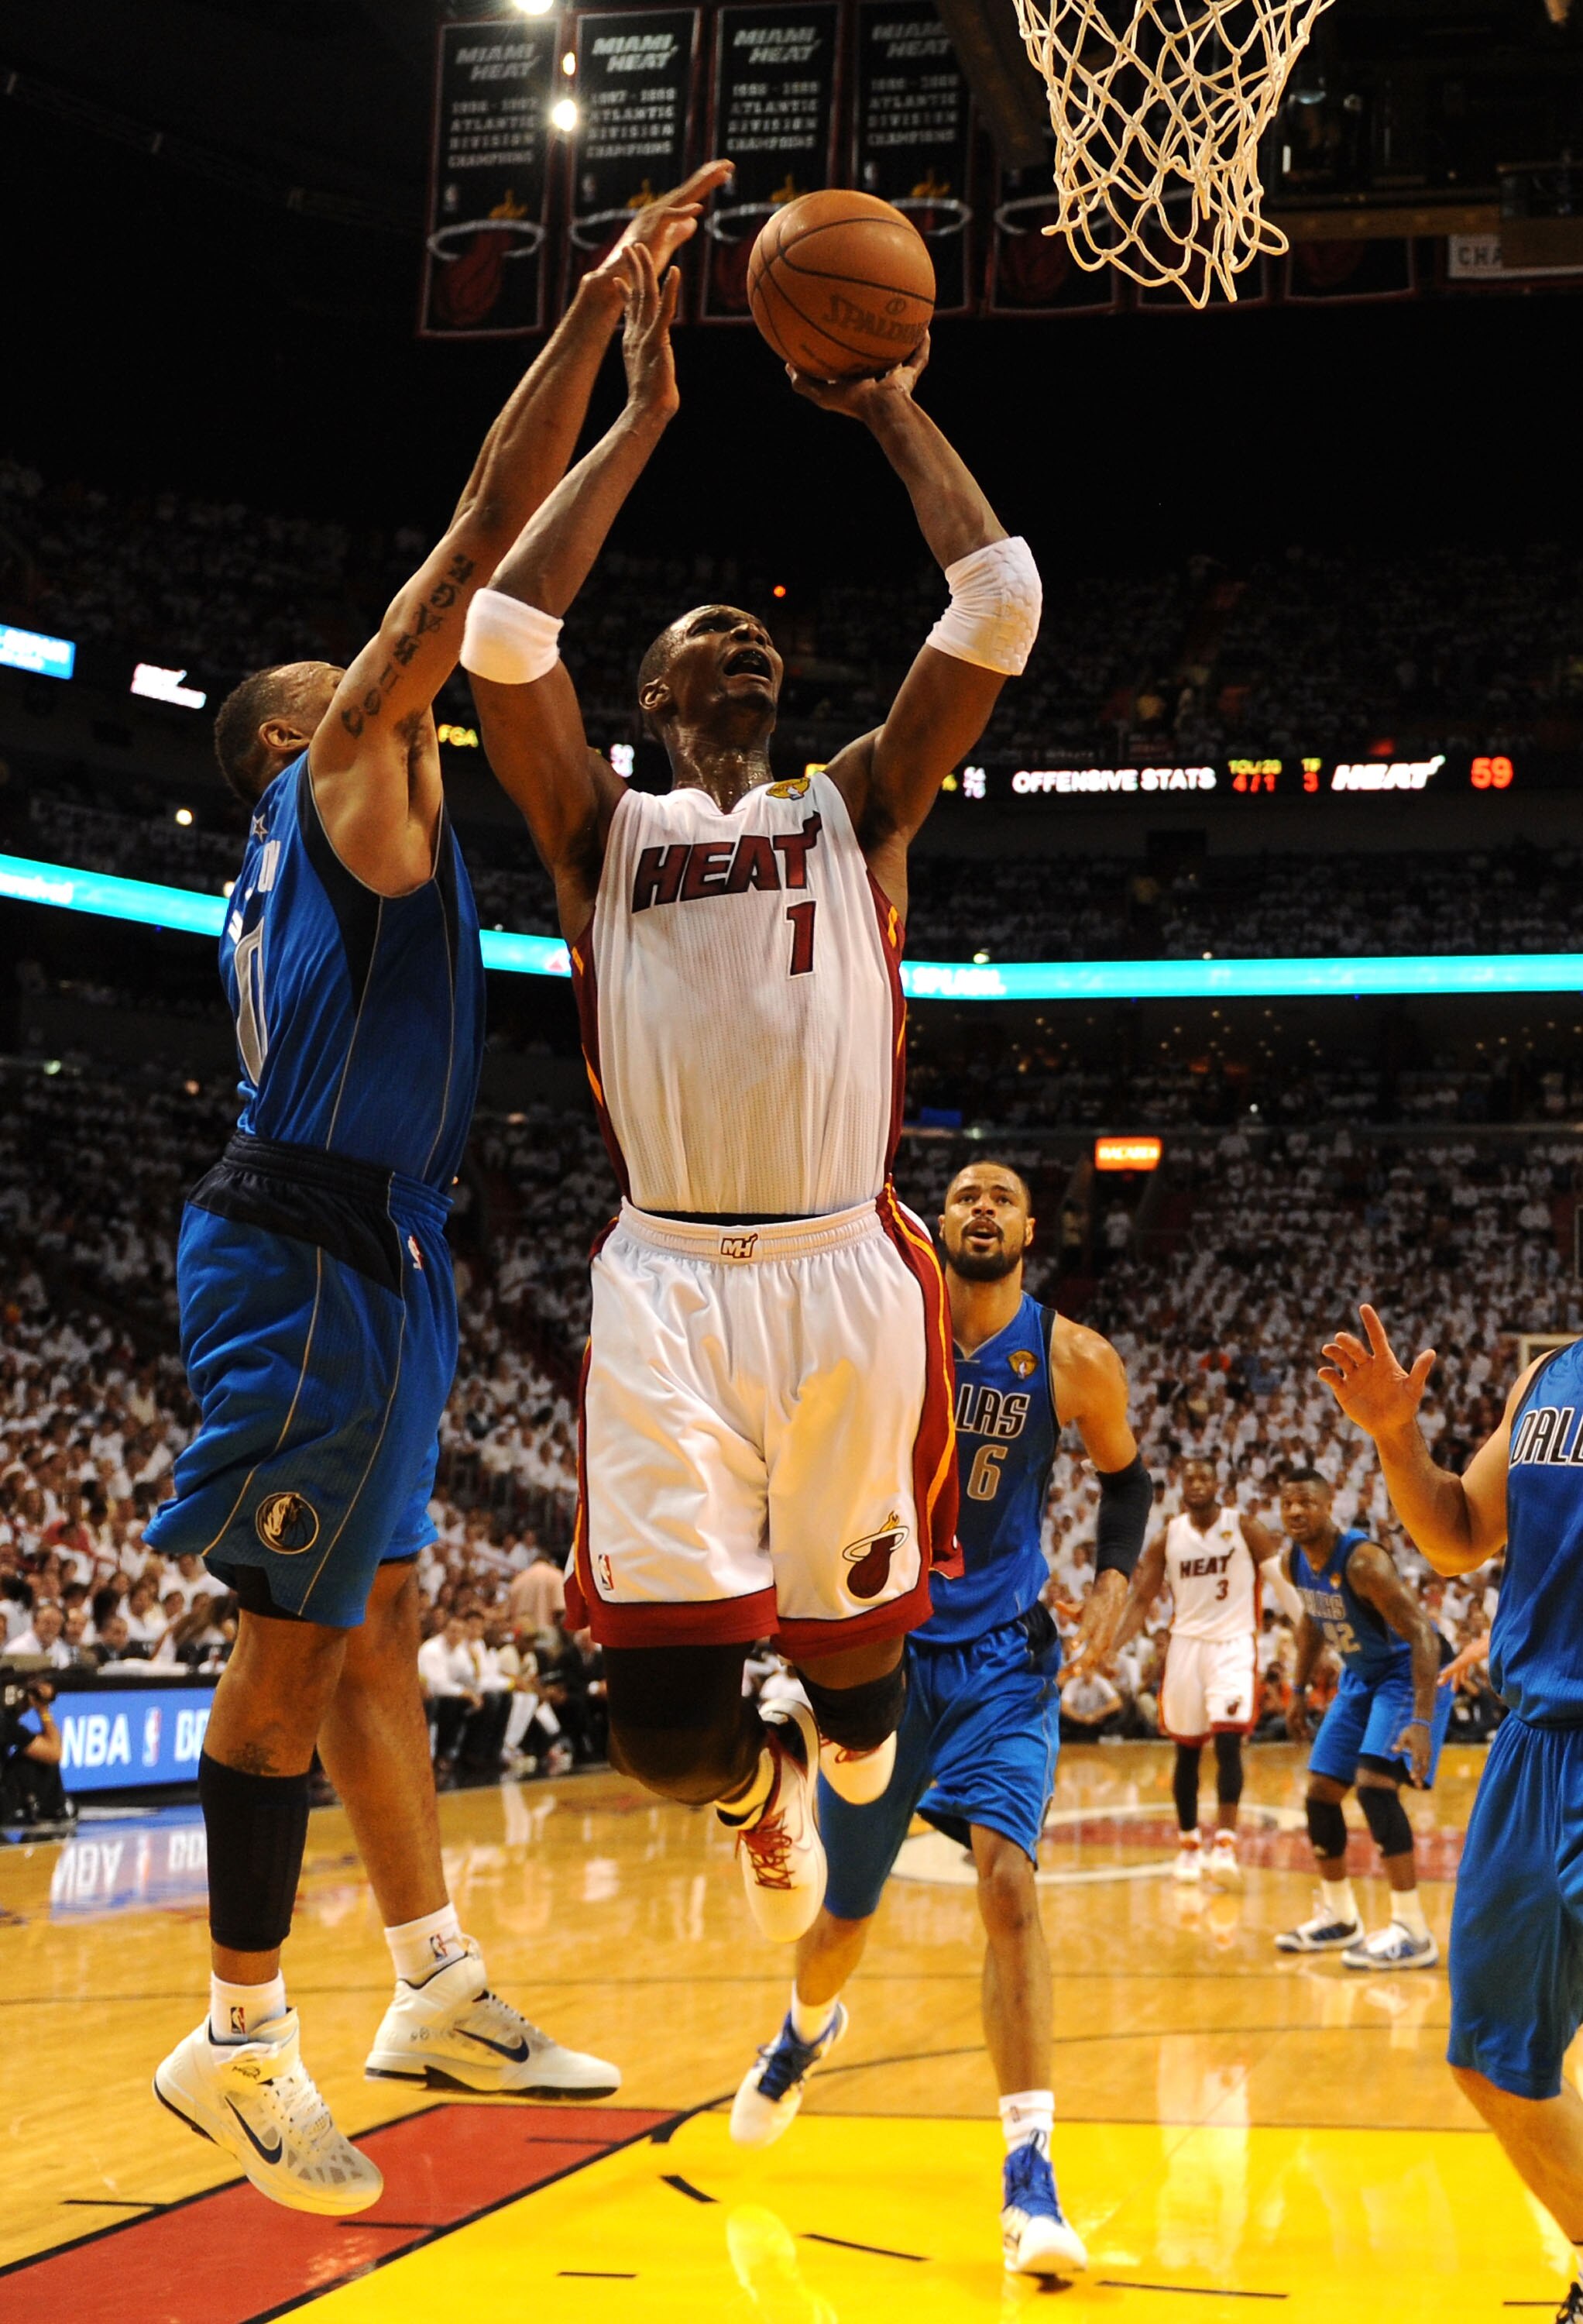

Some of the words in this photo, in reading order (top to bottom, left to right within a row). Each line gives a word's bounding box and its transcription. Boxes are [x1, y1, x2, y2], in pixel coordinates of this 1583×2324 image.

[592, 34, 673, 55] MIAMI
[733, 26, 816, 46] MIAMI
[455, 43, 534, 64] MIAMI
[606, 46, 678, 73] HEAT
[748, 39, 822, 64] HEAT
[471, 56, 542, 81] HEAT
[731, 99, 818, 115] ATLANTIC
[869, 93, 957, 110] ATLANTIC
[589, 105, 675, 122] ATLANTIC
[867, 111, 958, 129] DIVISION
[451, 116, 534, 132] ATLANTIC
[587, 123, 675, 139] DIVISION
[728, 117, 818, 133] DIVISION
[449, 132, 534, 150] DIVISION
[726, 135, 816, 152] CHAMPIONS
[867, 129, 956, 146] CHAMPIONS
[448, 150, 534, 169] CHAMPIONS
[585, 140, 672, 159] CHAMPIONS
[1012, 768, 1139, 793] OFFENSIVE
[1141, 767, 1217, 791] STATS
[1331, 756, 1445, 791] HEAT
[1471, 756, 1513, 789] 59
[632, 810, 822, 914] HEAT
[786, 900, 818, 978] 1
[967, 1444, 1008, 1501] 6
[1180, 1547, 1236, 1579] HEAT
[1215, 1580, 1229, 1600] 3
[60, 1713, 132, 1769] NBA
